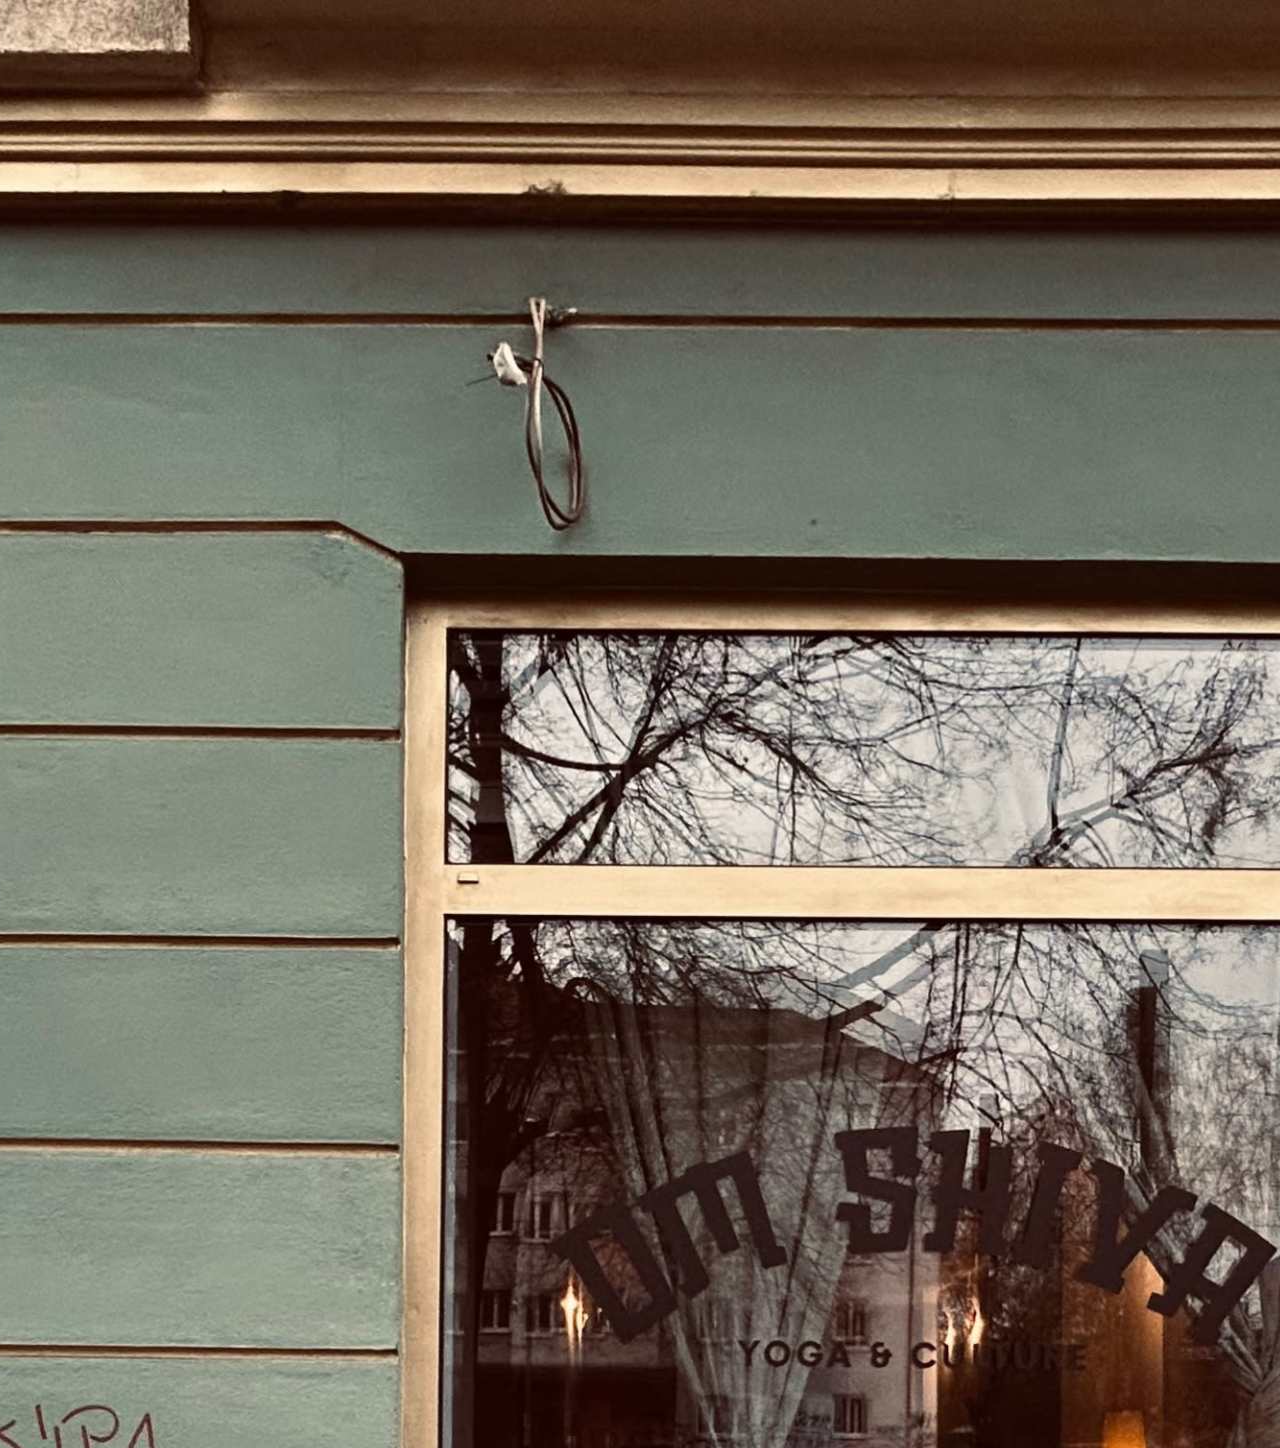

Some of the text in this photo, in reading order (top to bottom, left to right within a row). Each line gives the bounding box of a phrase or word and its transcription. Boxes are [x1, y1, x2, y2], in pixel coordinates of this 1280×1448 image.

[551, 1125, 1278, 1347] OM SHIVA
[738, 1339, 1088, 1373] YOGA & CULTURE
